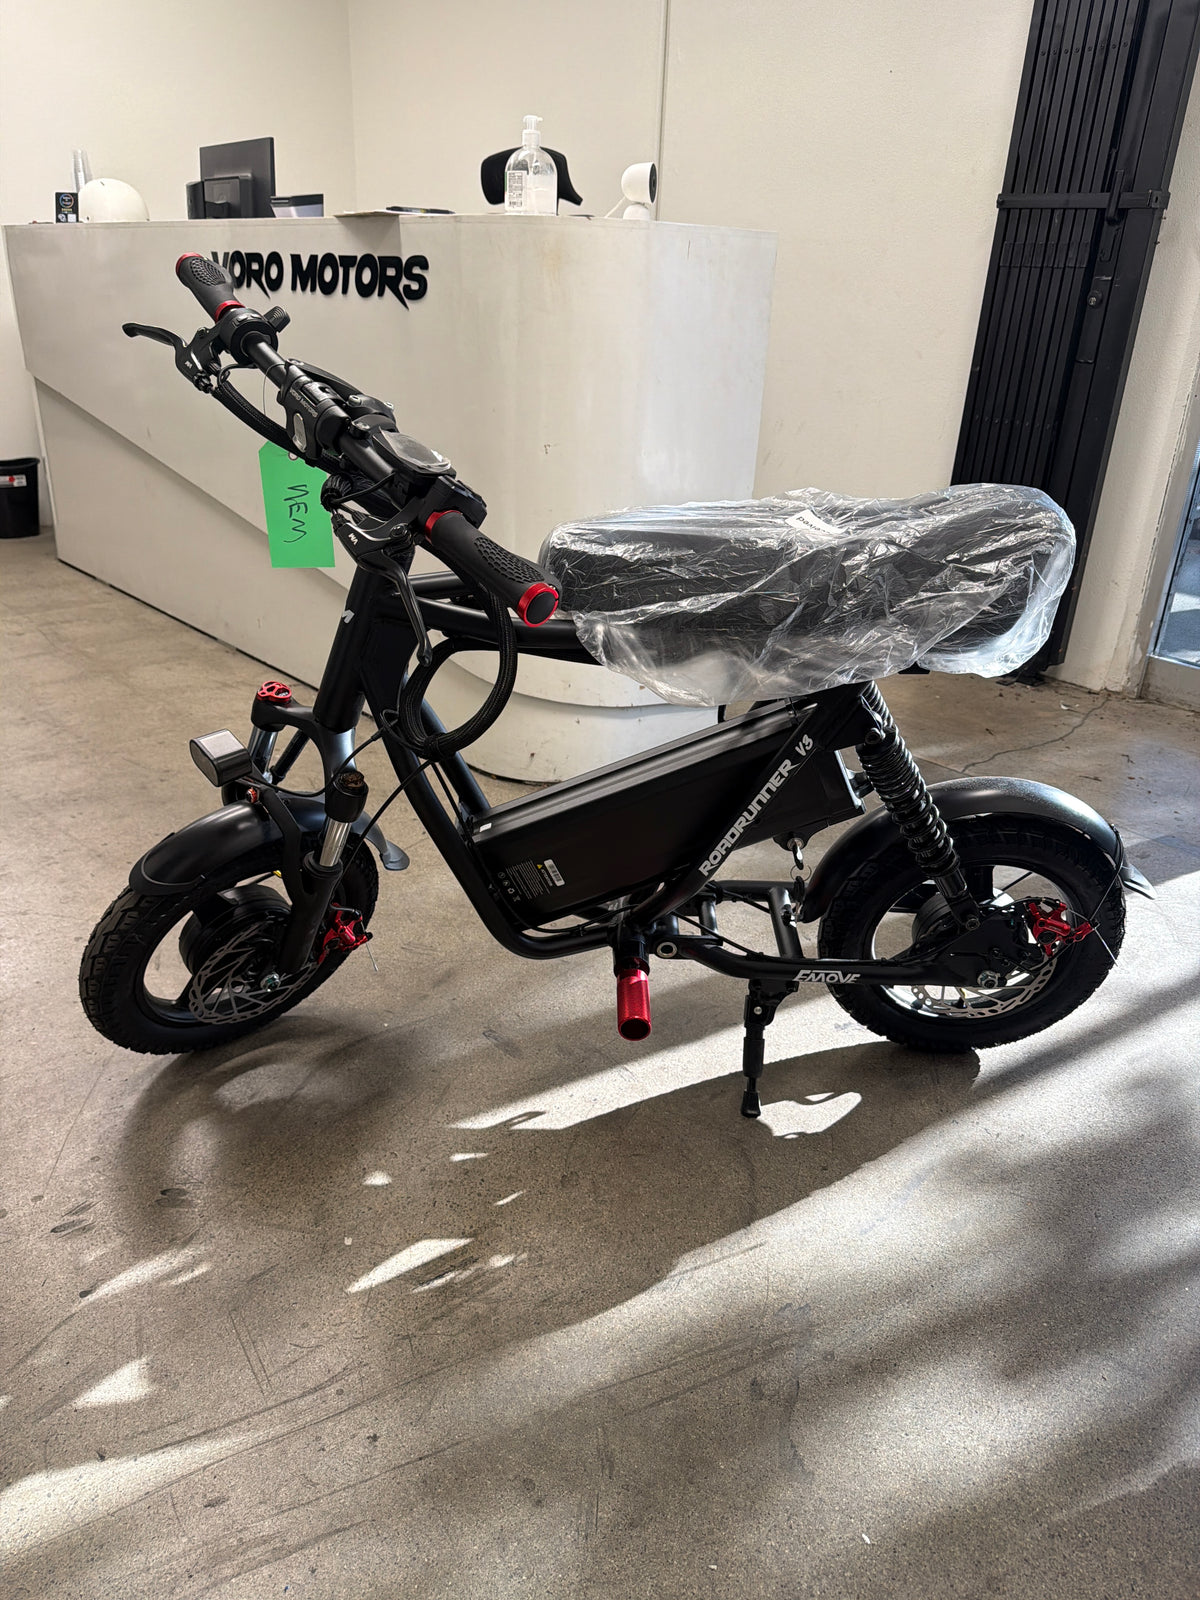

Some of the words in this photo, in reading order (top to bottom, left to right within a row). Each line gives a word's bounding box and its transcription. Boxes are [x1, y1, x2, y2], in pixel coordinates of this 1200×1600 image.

[290, 252, 430, 311] MOTORS
[698, 758, 801, 877] ROADRUNNER
[794, 734, 814, 757] V3
[791, 969, 861, 984] EMOVE
